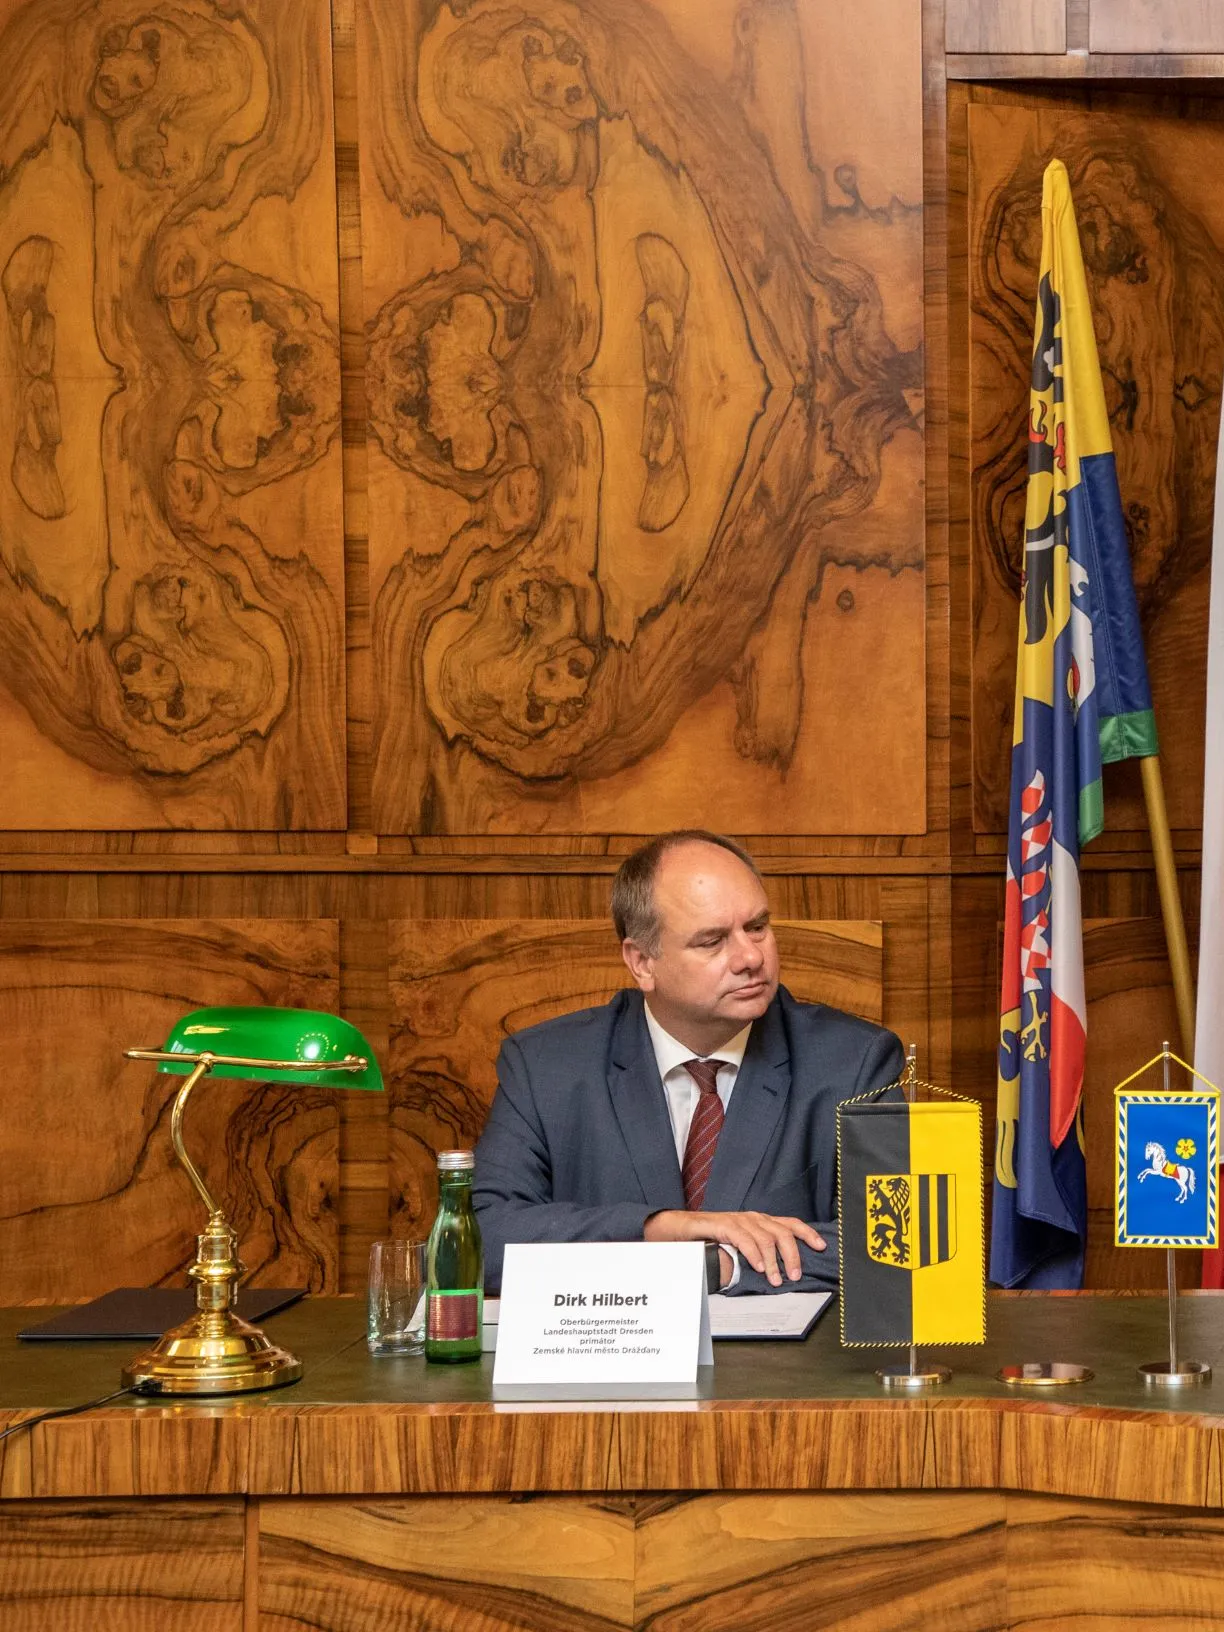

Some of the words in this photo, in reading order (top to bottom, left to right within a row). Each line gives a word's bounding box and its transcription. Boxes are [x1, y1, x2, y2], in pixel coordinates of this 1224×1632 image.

[553, 1293, 588, 1307] Dirk
[591, 1292, 649, 1307] Hilbert
[559, 1318, 639, 1327] Oberbürgermeister
[543, 1327, 617, 1336] Landeshauptstadt
[619, 1327, 654, 1335] Dresden
[579, 1337, 616, 1346] primátor
[532, 1346, 566, 1355] Zemské
[594, 1346, 620, 1355] město
